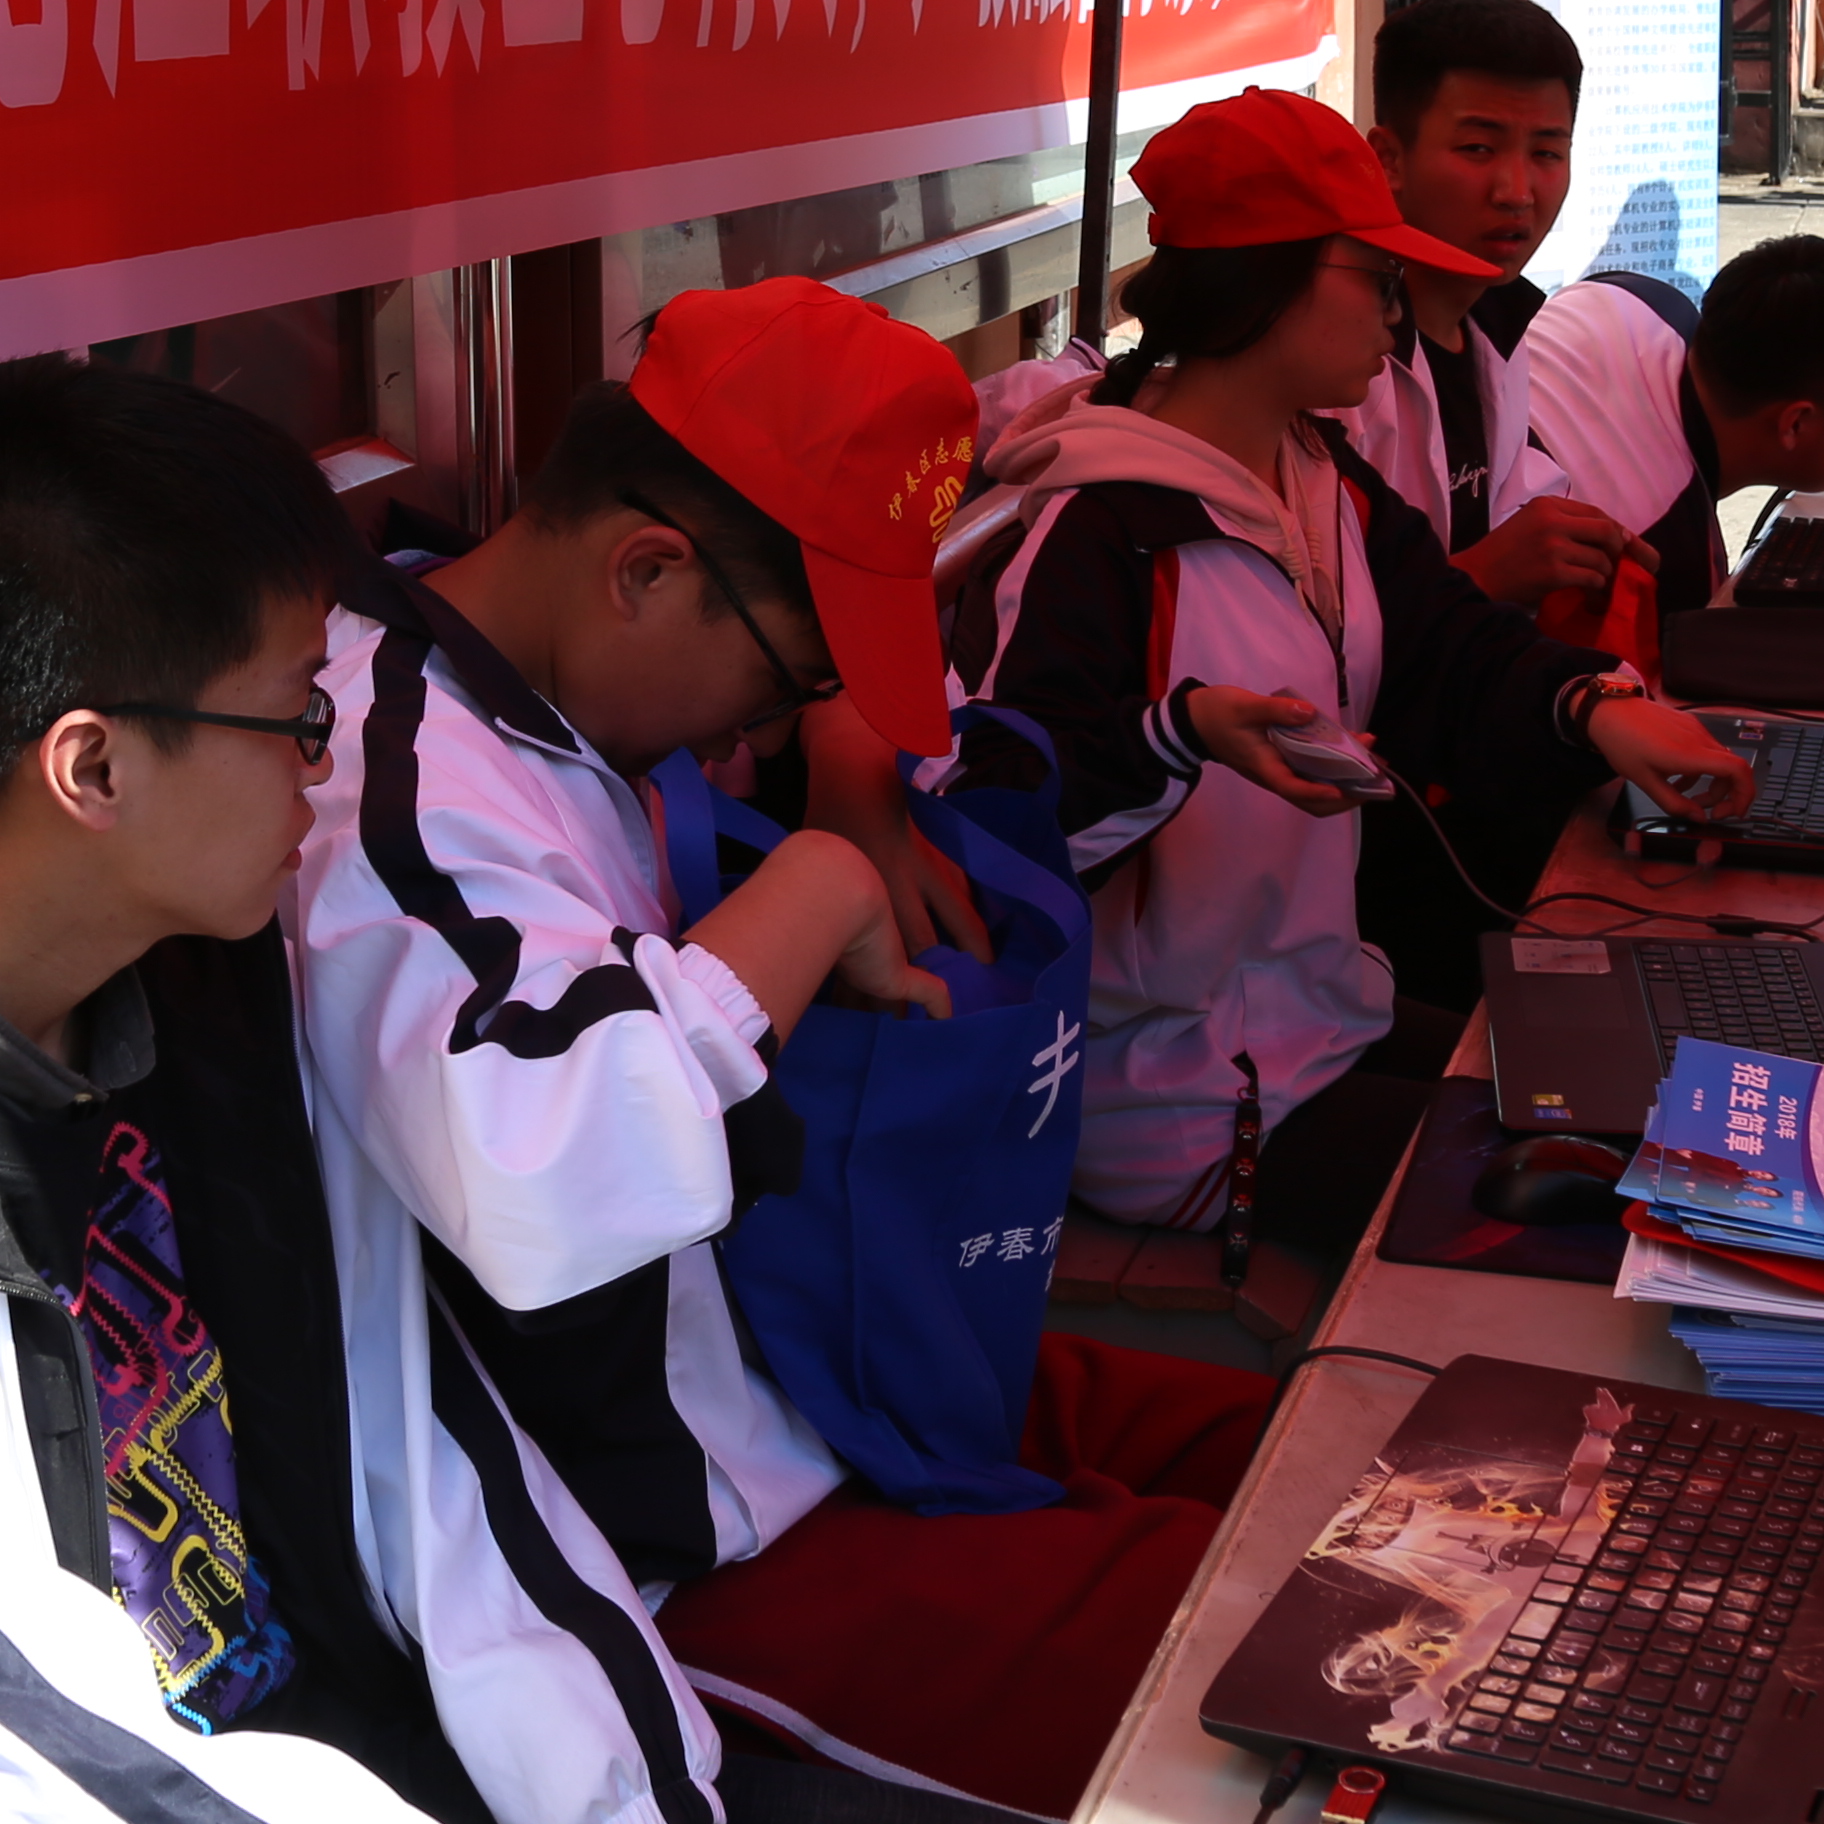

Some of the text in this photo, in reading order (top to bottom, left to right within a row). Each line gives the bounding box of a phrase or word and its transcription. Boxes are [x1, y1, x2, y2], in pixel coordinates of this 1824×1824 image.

[889, 436, 974, 521] 伊春区志愿
[1723, 1061, 1772, 1157] 招生简章
[1774, 1095, 1798, 1141] 2018年
